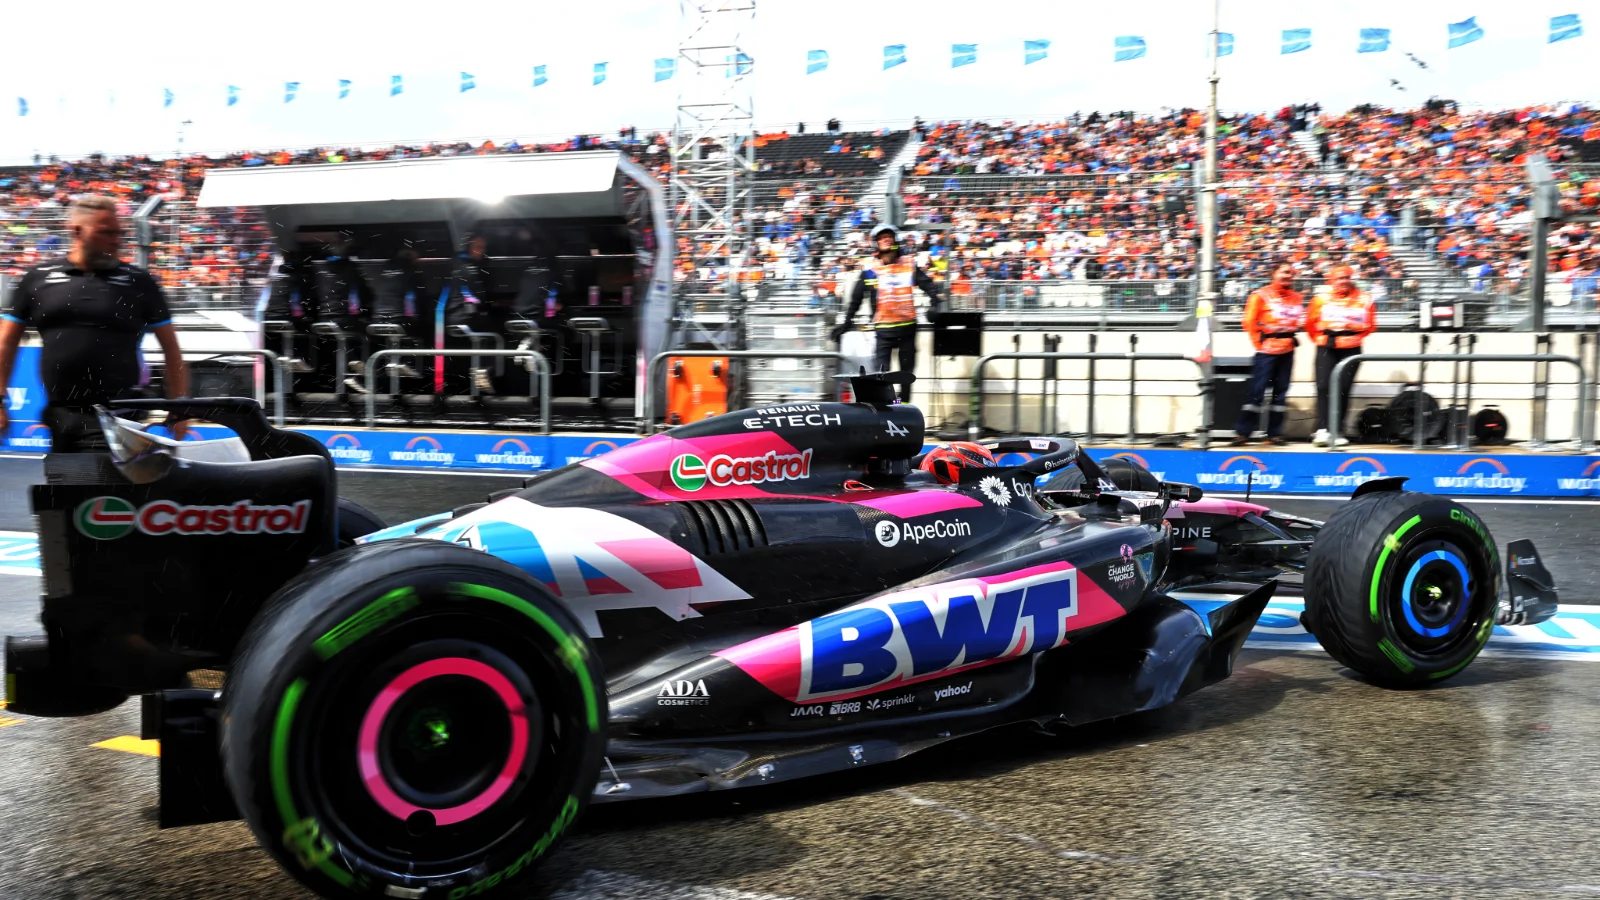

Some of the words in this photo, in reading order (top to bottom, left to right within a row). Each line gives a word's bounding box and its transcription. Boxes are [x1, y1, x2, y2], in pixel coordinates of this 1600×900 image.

[756, 404, 821, 417] RENAULT
[743, 413, 841, 430] E-TECH
[328, 446, 373, 462] orkday
[388, 448, 456, 465] workday
[474, 451, 545, 468] workday
[707, 448, 813, 487] Castrol
[1196, 470, 1285, 489] workday
[1313, 471, 1386, 486] work
[1433, 472, 1527, 492] workday
[1012, 477, 1033, 501] bp
[138, 498, 312, 535] Castrol
[903, 519, 971, 544] ApeCoin
[1172, 527, 1211, 539] PINE
[1450, 508, 1497, 564] Cintu
[1108, 563, 1134, 577] CHANGE
[1113, 571, 1135, 583] WORLD
[803, 573, 1076, 698] BWT
[657, 679, 711, 697] ADA
[934, 681, 973, 702] yahoo!
[841, 702, 862, 714] BRB
[882, 694, 915, 710] sprinklr
